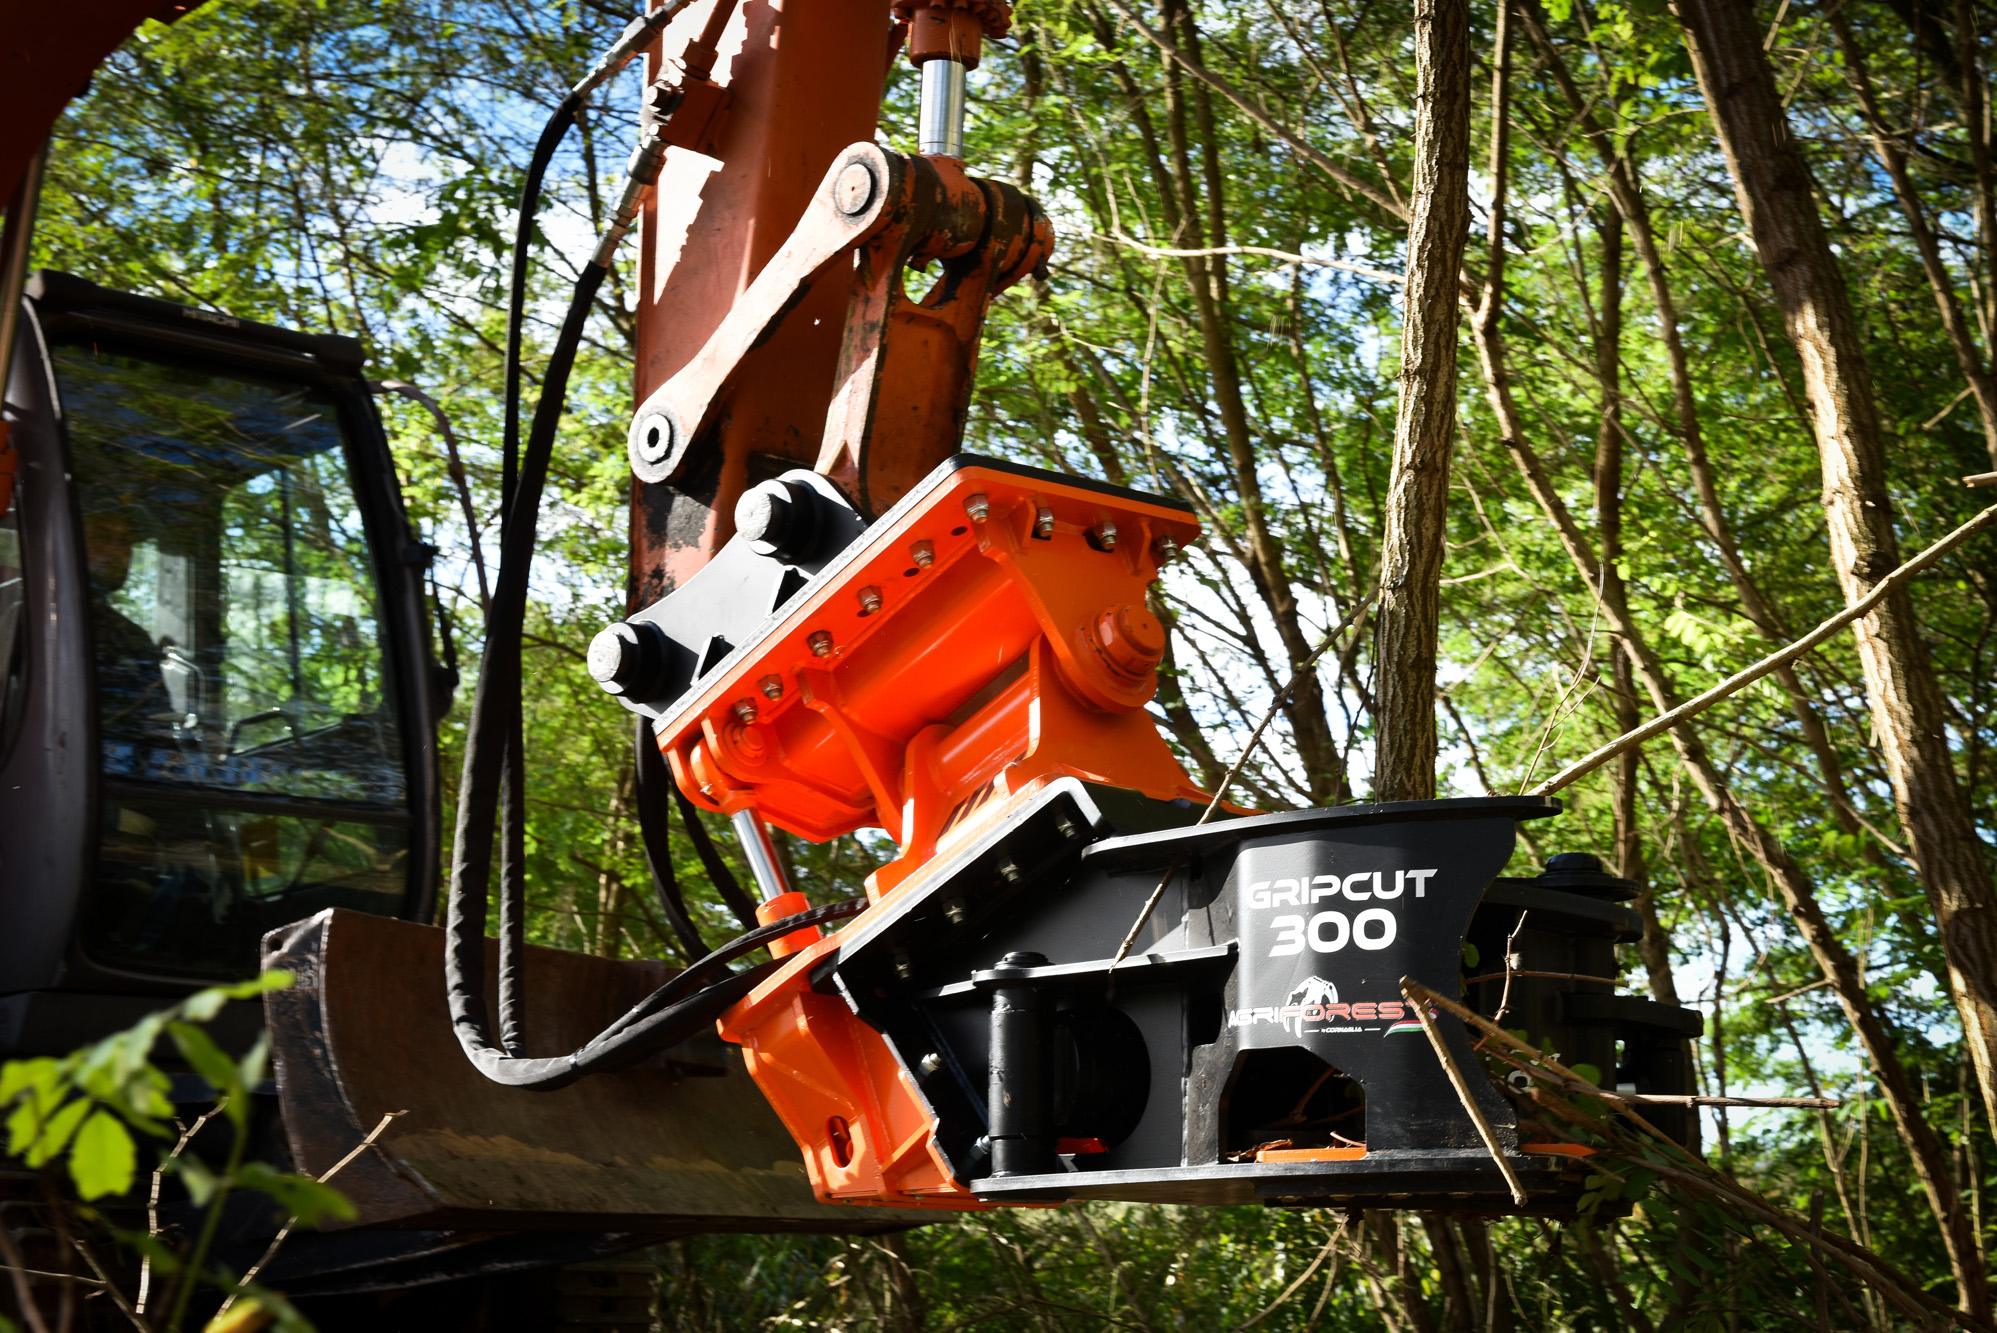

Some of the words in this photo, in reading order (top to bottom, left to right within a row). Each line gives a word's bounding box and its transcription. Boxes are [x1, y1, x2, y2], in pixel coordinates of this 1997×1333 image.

[1250, 868, 1438, 910] GRIPCUT
[1268, 907, 1397, 957] 300
[1227, 999, 1430, 1028] AGRIFORES
